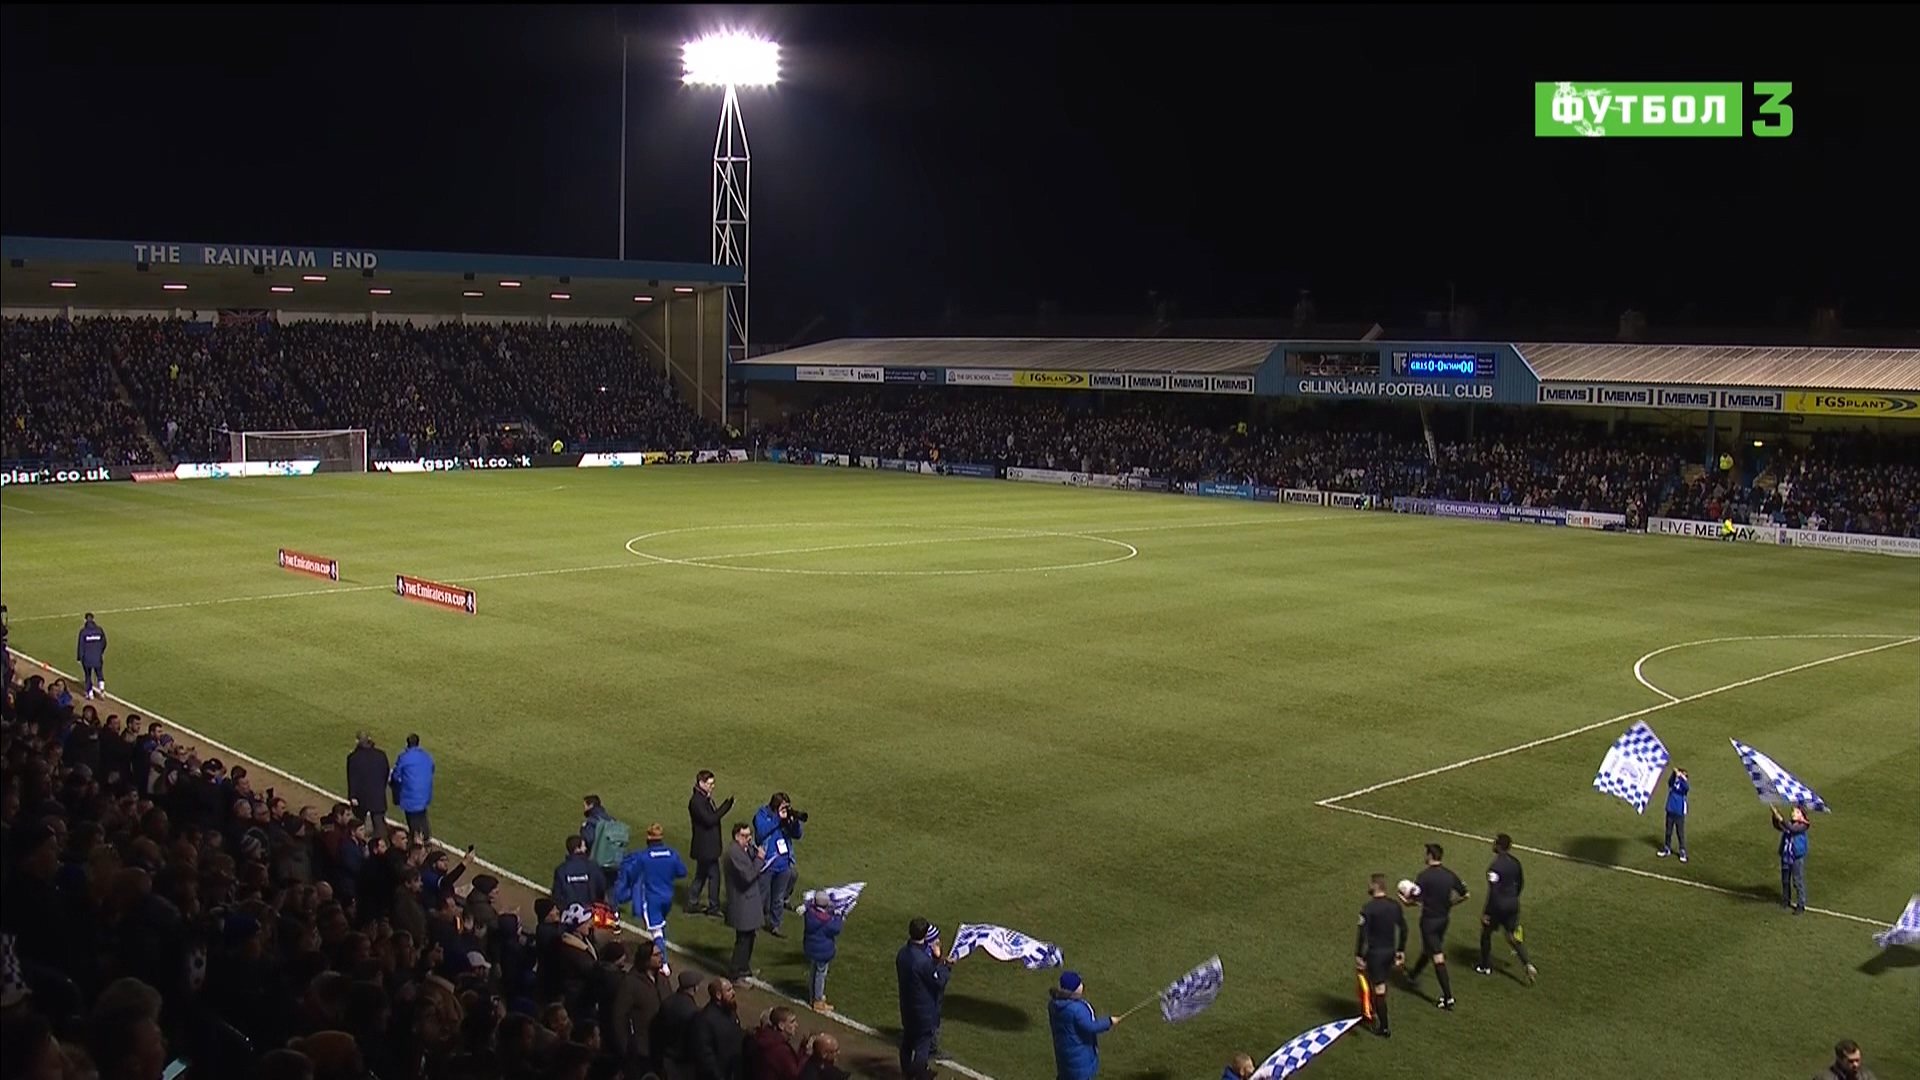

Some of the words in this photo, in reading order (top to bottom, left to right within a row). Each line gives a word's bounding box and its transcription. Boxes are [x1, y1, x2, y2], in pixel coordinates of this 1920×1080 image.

[134, 244, 180, 263] THE
[204, 247, 317, 267] RAINHAM
[332, 251, 377, 268] END
[1094, 376, 1121, 386] MEMS
[1131, 377, 1161, 388] MEMS
[1173, 378, 1203, 388] MEMS
[1216, 379, 1248, 390] MEMS
[1299, 380, 1376, 395] GILLINGHAM
[1378, 382, 1450, 397] FOOTBALL
[1454, 384, 1493, 399] CLUB
[1546, 388, 1587, 400] MEMS
[1604, 390, 1647, 403] MEMS
[1665, 392, 1709, 405] MEMS
[1728, 394, 1774, 407] MEMS
[1287, 494, 1319, 504] MEMS
[1436, 504, 1477, 514] RECRUITING
[1479, 507, 1498, 516] NOW
[1568, 513, 1582, 526] Flint
[1659, 520, 1691, 534] LIVE
[1800, 532, 1817, 541] DCB
[1818, 535, 1844, 544] (Kent)
[1845, 537, 1877, 547] Limited
[285, 556, 293, 566] THE
[294, 556, 314, 570] Emirates
[320, 564, 330, 574] CUP
[405, 583, 416, 595] THE
[416, 583, 444, 602] Emirates
[444, 593, 452, 604] FA
[452, 594, 465, 606] CUP
